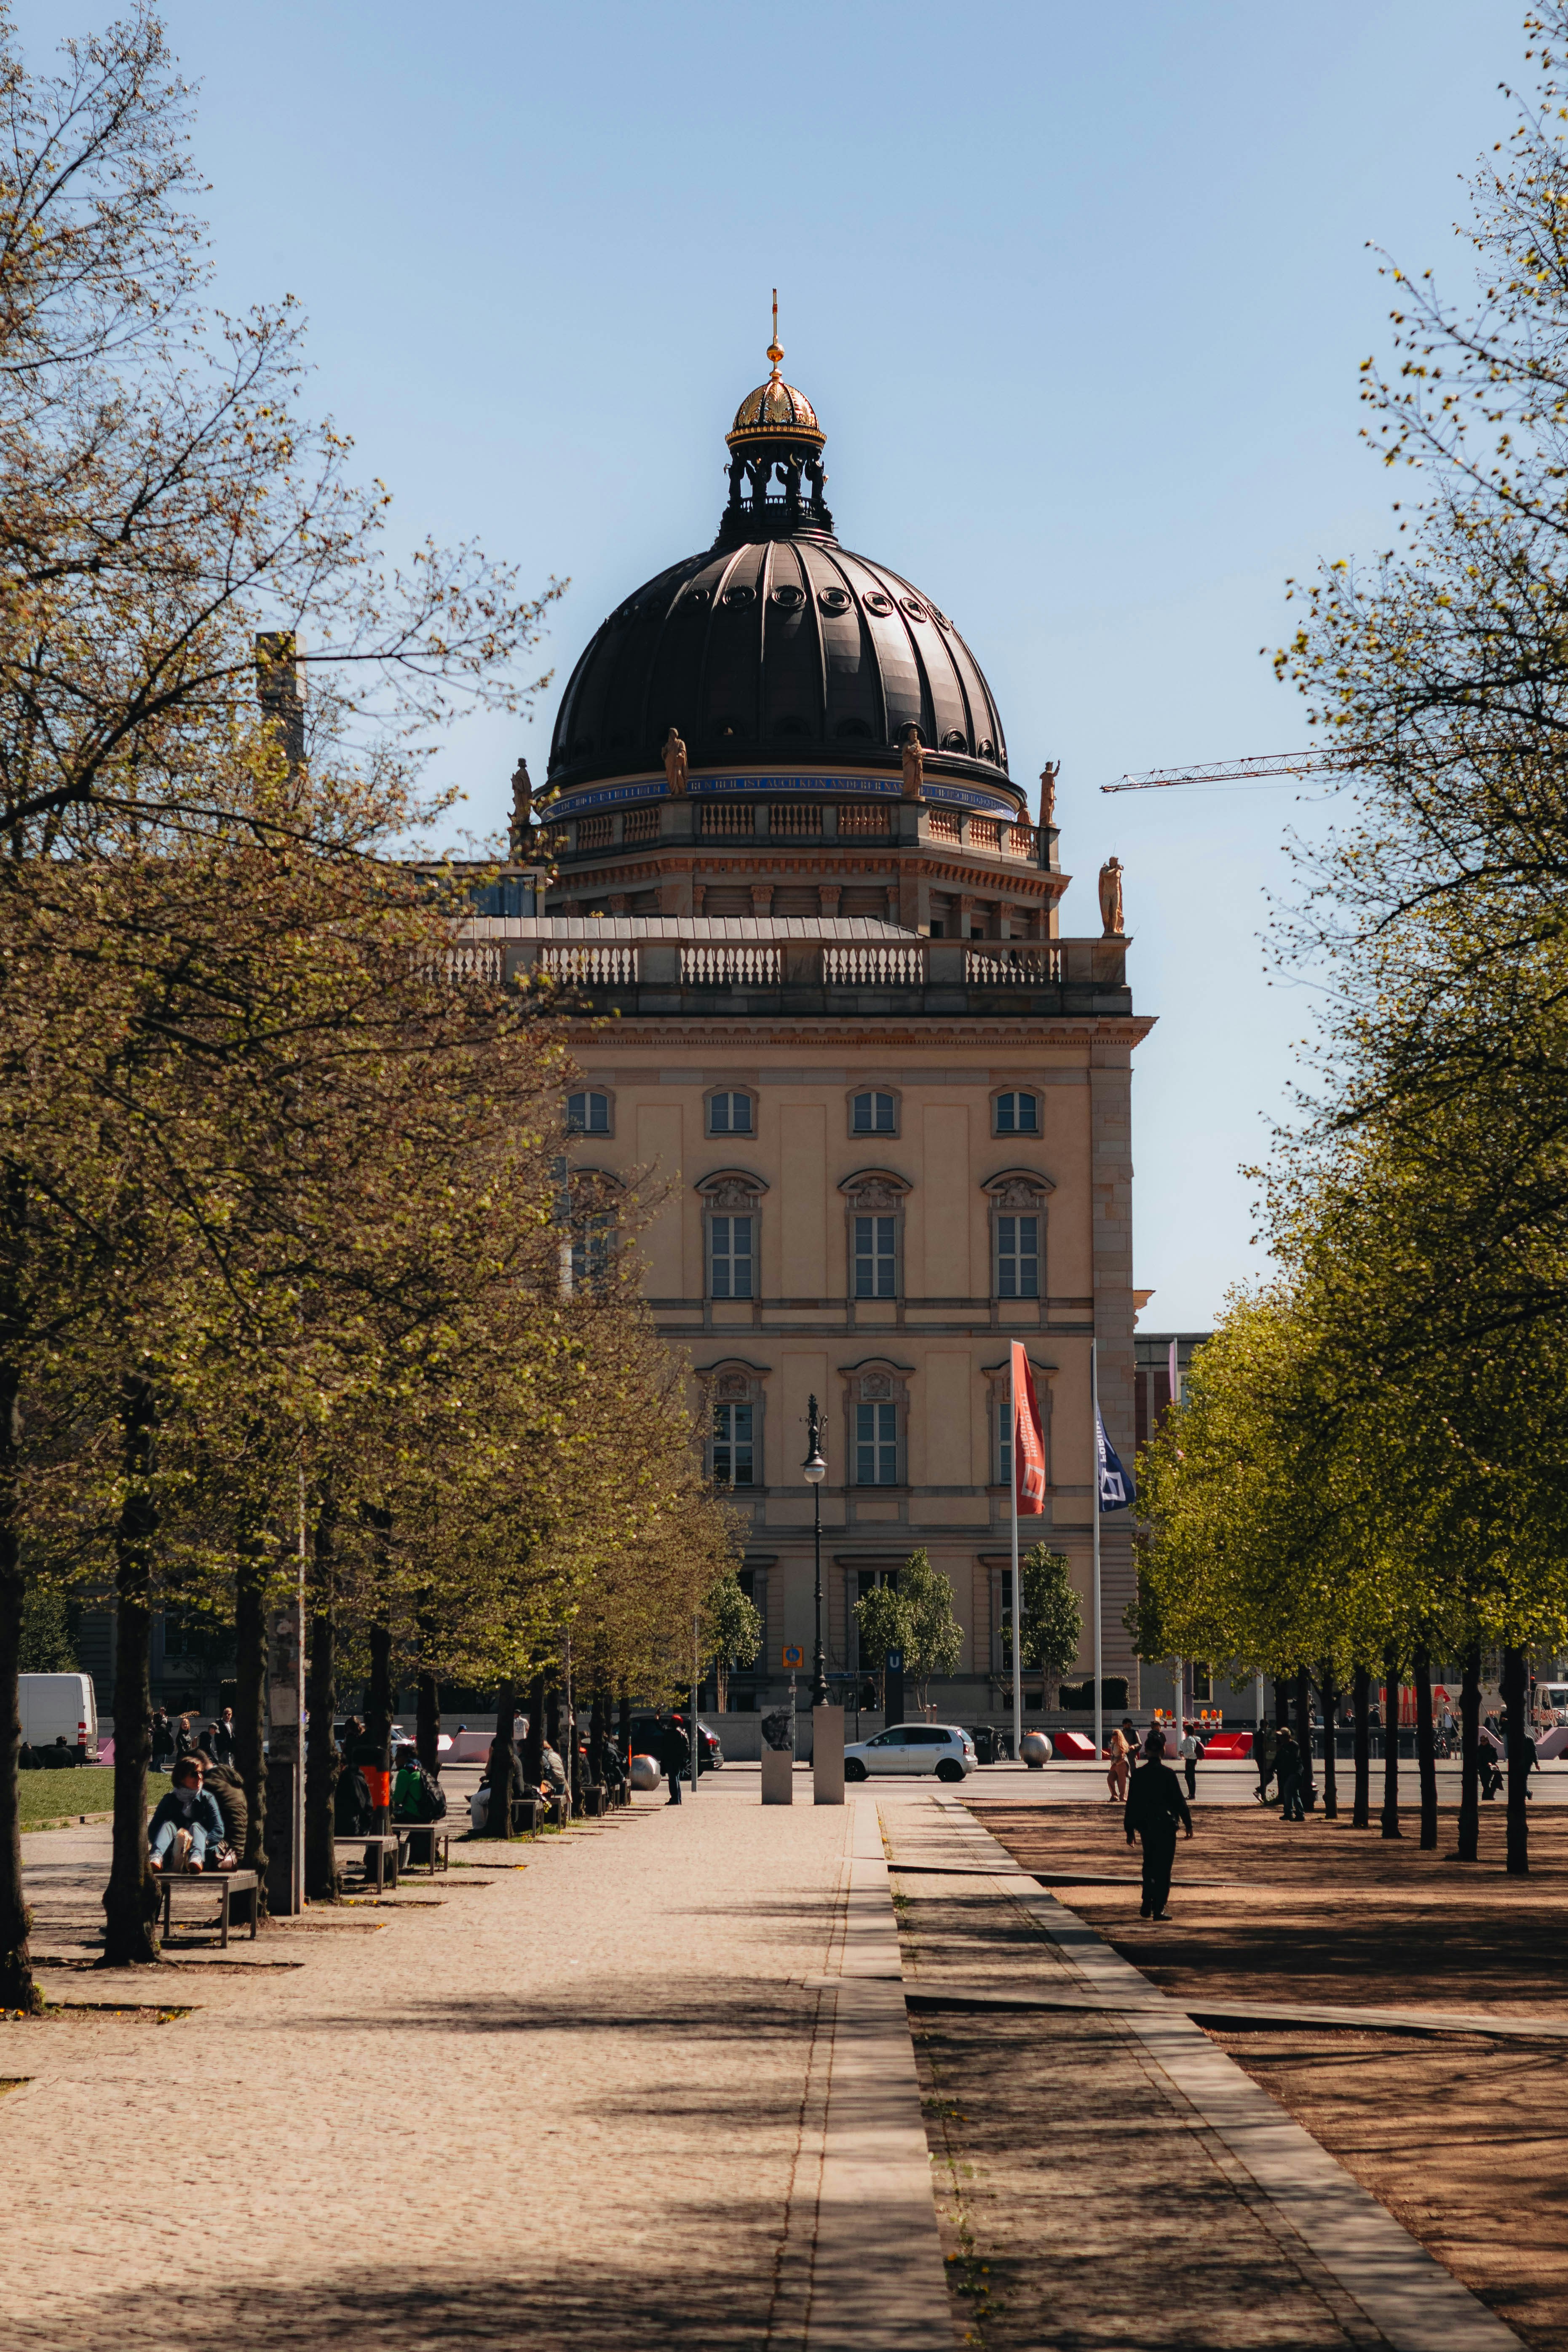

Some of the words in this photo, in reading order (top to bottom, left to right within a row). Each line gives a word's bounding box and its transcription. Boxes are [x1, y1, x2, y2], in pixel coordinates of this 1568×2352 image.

[744, 779, 763, 788] IST
[765, 778, 796, 787] AUCH
[799, 779, 826, 788] KEIN
[831, 779, 881, 790] ANDERER
[889, 1656, 899, 1669] U
